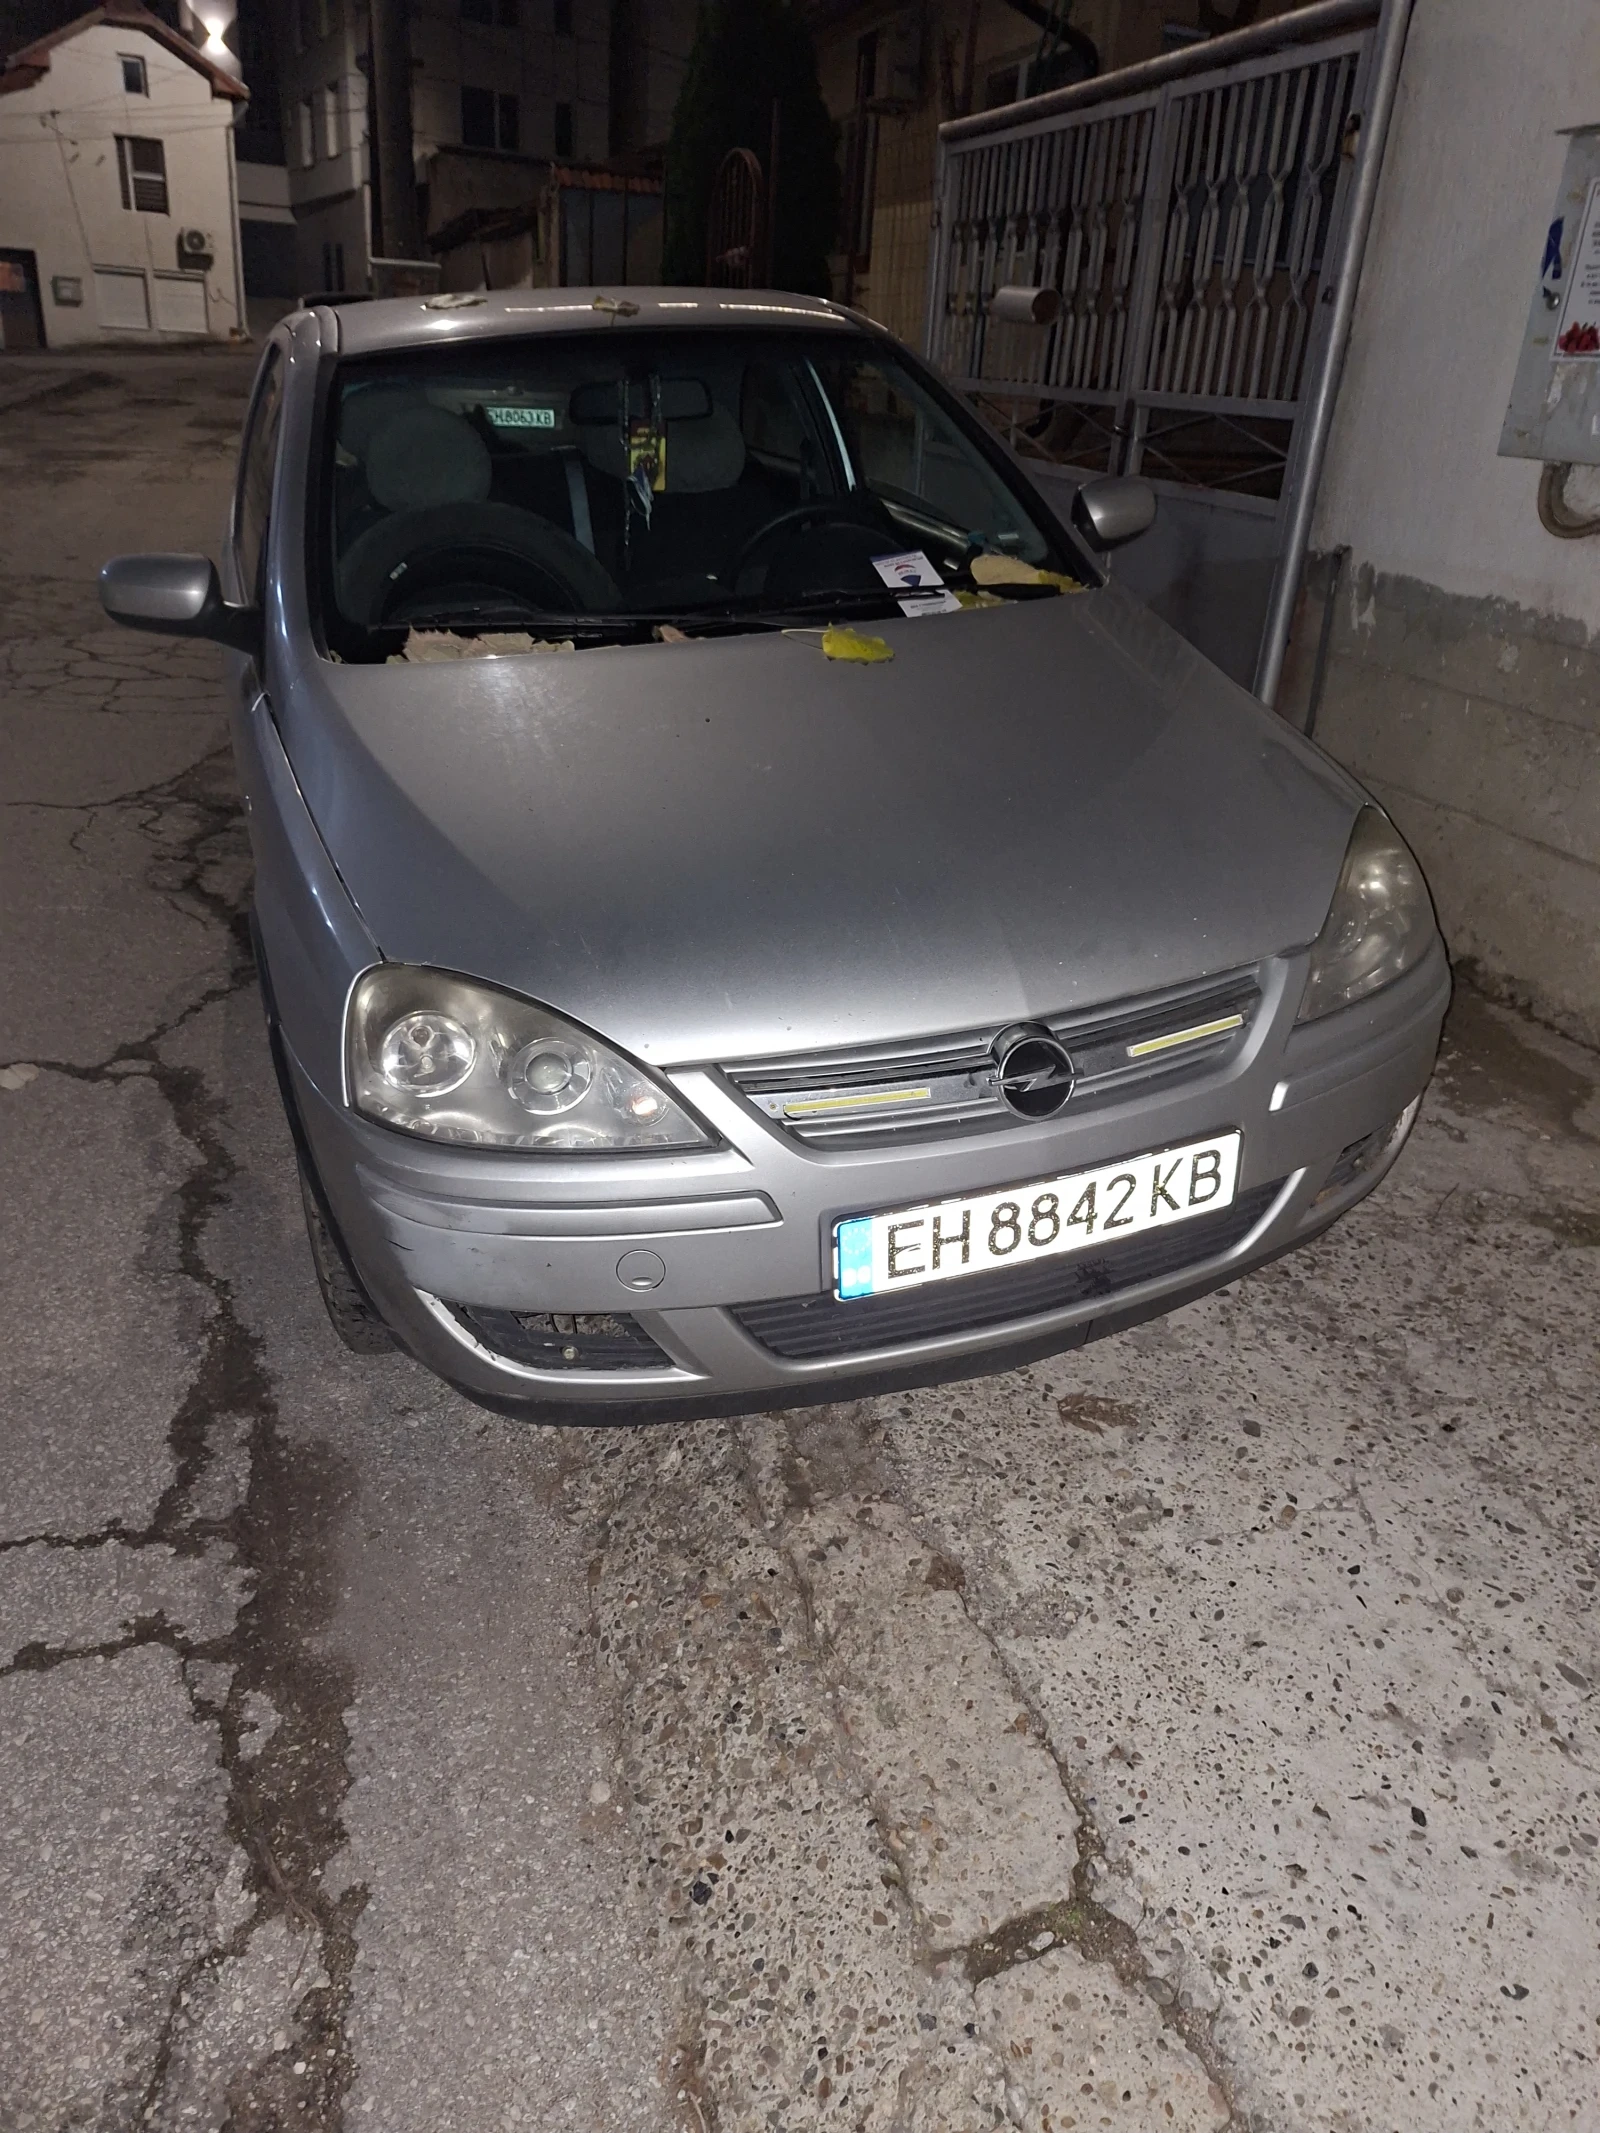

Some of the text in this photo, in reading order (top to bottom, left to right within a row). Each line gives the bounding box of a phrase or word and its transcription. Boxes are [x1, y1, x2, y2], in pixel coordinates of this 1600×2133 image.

[887, 1149, 1222, 1279] EH 8842 KB
